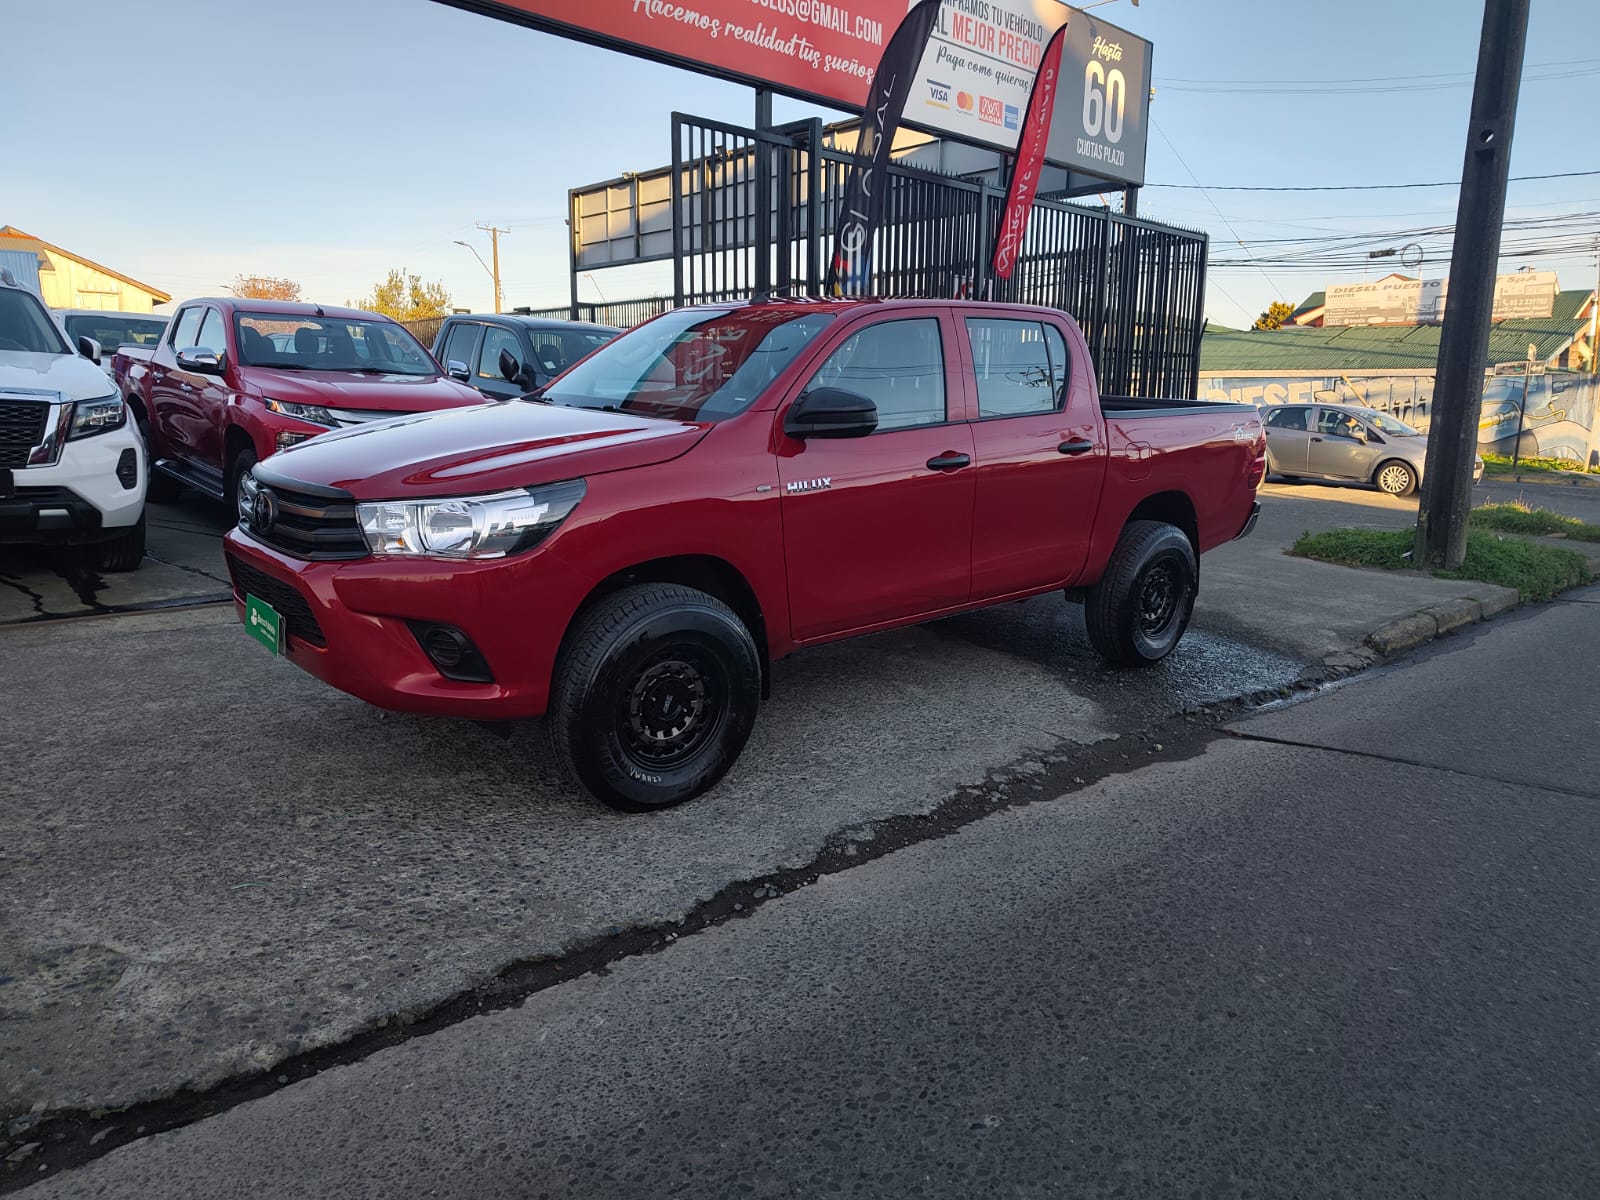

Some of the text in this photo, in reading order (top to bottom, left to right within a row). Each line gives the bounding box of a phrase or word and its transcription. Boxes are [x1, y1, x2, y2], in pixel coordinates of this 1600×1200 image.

[991, 5, 1003, 27] TU
[1004, 12, 1043, 42] VEHÍCULO
[724, 22, 798, 57] realidad
[824, 54, 875, 85] sueños
[952, 12, 995, 54] MEJOR
[998, 30, 1041, 70] PRECIO
[1091, 35, 1123, 62] Hasta
[935, 45, 966, 72] Paga
[967, 60, 992, 78] como
[930, 86, 949, 103] VISA
[1082, 60, 1126, 144] 60
[1076, 138, 1125, 167] CUOTAS PLAZO
[786, 476, 832, 494] HILUX
